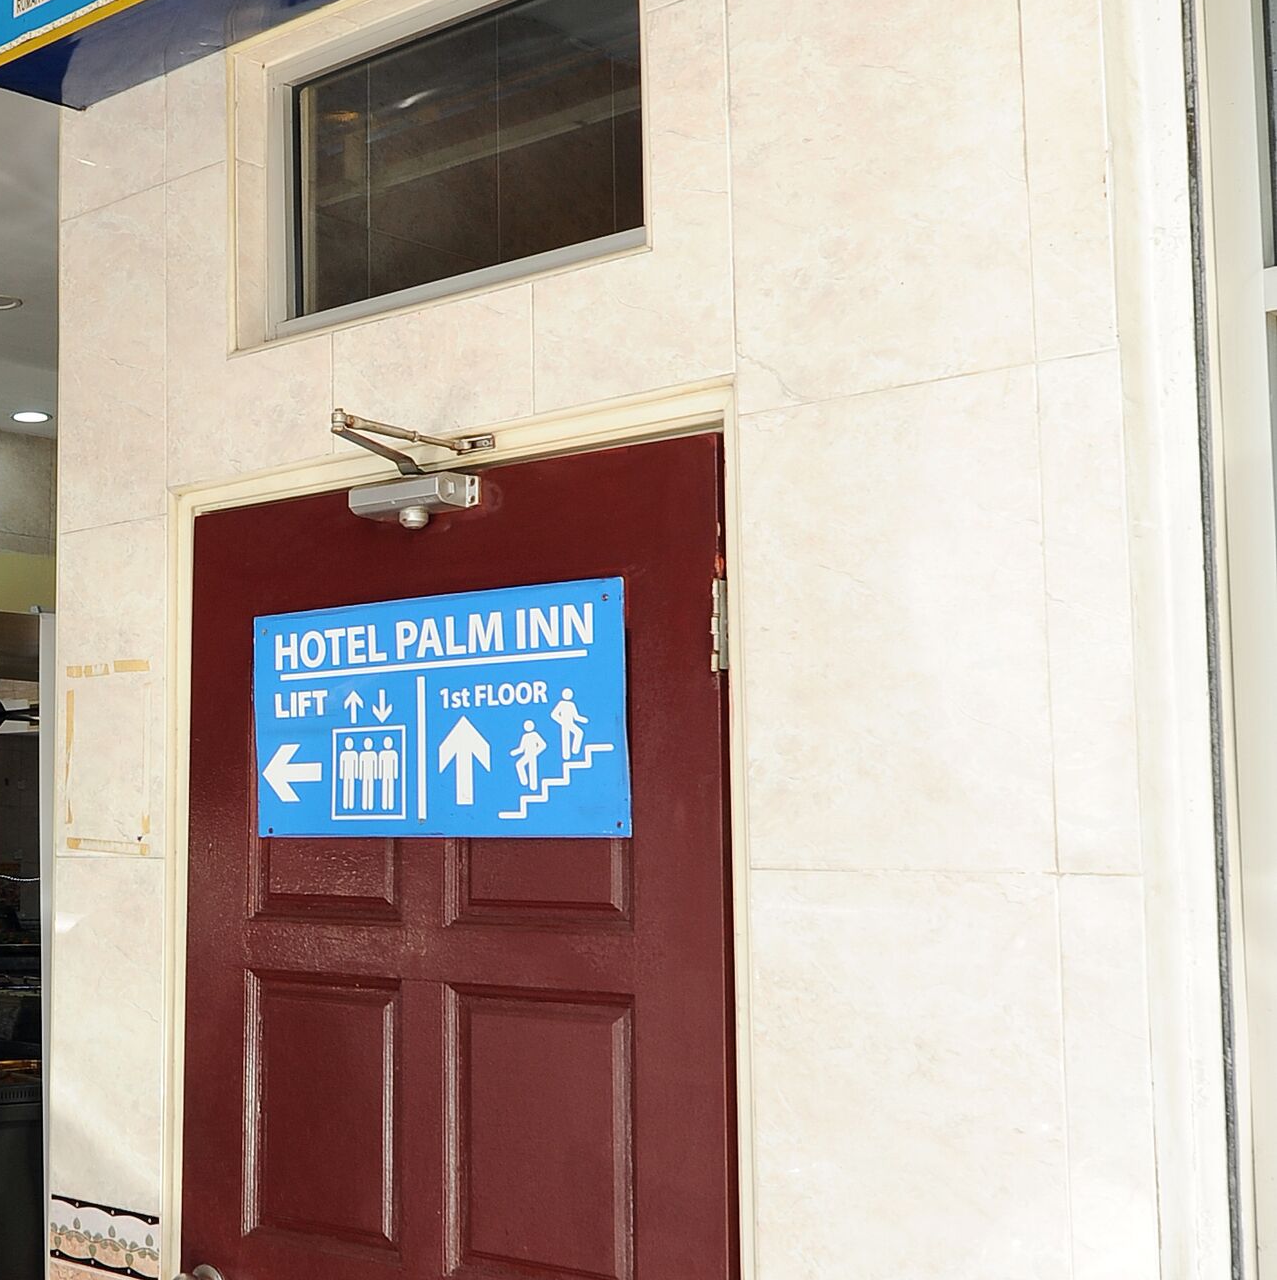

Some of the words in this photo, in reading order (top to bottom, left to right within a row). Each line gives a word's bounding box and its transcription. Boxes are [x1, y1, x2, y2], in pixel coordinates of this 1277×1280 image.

[275, 625, 387, 671] HOTEL
[396, 611, 504, 660] PALM
[516, 603, 593, 650] INN
[275, 689, 328, 719] LIFT
[440, 686, 470, 710] 1st
[475, 681, 548, 707] FLOOR
